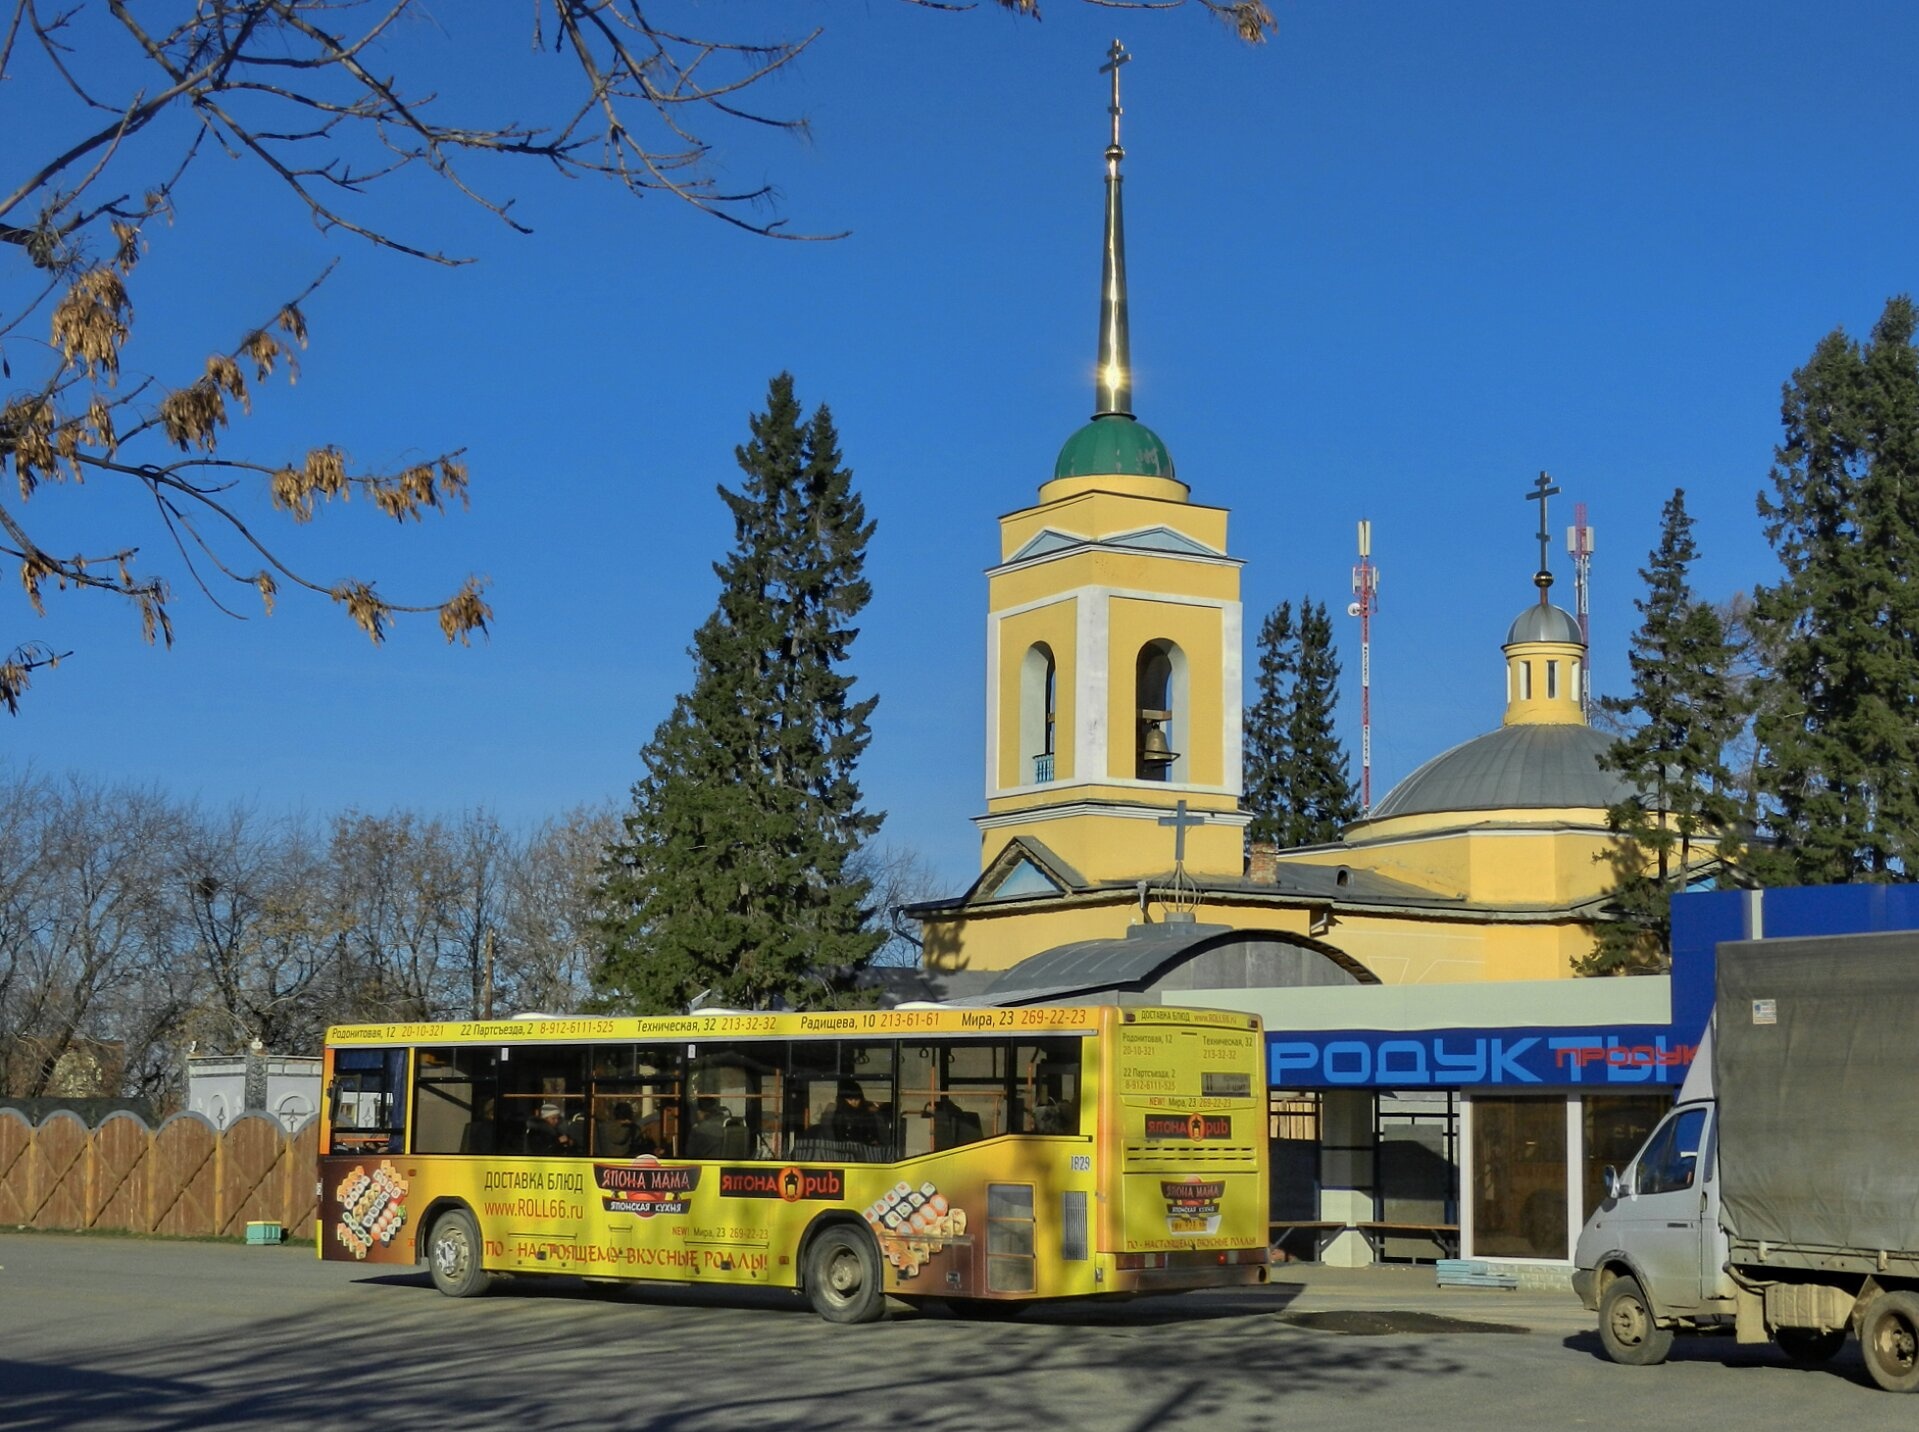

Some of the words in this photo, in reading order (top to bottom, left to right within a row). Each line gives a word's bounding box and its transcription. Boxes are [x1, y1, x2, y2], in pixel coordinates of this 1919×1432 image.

[637, 1019, 700, 1033] Техническая,
[703, 1018, 716, 1031] 32
[721, 1016, 777, 1030] 213-32-32
[800, 1015, 858, 1030] Радищева,
[862, 1015, 876, 1028] 10
[880, 1012, 940, 1027] 213-61-61
[961, 1012, 995, 1029] Мира,
[999, 1010, 1014, 1026] 23
[1020, 1009, 1087, 1025] 269-22-23
[1141, 1010, 1171, 1021] ДОСТАВКА
[1172, 1011, 1191, 1022] БЛЮД
[332, 1027, 383, 1039] Родонитовая,
[386, 1027, 396, 1038] 12
[401, 1025, 445, 1037] 20-10-321
[460, 1024, 472, 1036] 22
[473, 1022, 525, 1038] Партсъезда,
[527, 1023, 533, 1034] 2
[540, 1021, 614, 1034] 8-912-6111-525
[1165, 1034, 1173, 1044] 12
[1202, 1035, 1244, 1048] Техническая,
[1245, 1037, 1253, 1048] 32
[1122, 1045, 1155, 1056] 20-10-321
[1203, 1049, 1237, 1060] 213-32-32
[1556, 1044, 1700, 1068] ПРОДУК
[1270, 1035, 1667, 1085] РОДУКТЫ
[1123, 1067, 1132, 1078] 22
[1168, 1098, 1187, 1108] Мира,
[1188, 1098, 1197, 1108] 23
[1147, 1120, 1187, 1134] ЯПОНА
[1206, 1118, 1229, 1137] pub
[1071, 1156, 1090, 1170] 1829
[484, 1171, 544, 1191] ДОСТАВКА
[547, 1173, 584, 1194] БЛЮД
[601, 1169, 646, 1190] ЯПОНА
[651, 1171, 691, 1190] МАМА
[722, 1175, 778, 1191] ЯПОНА
[805, 1171, 840, 1197] pub
[484, 1198, 584, 1219] www.ROLL66.ru
[610, 1201, 650, 1212] ЯПОНСКАЯ
[655, 1202, 682, 1213] КУХНЯ
[672, 1227, 690, 1237] NEW!
[693, 1228, 715, 1240] Мира,
[717, 1228, 726, 1238] 23
[729, 1228, 769, 1240] 269-22-23
[485, 1240, 504, 1256] ПО
[518, 1243, 620, 1264] НАСТОЯЩЕМУ
[627, 1248, 698, 1267] ВКУСНЫЕ
[704, 1251, 768, 1270] РОЛЛЫ!
